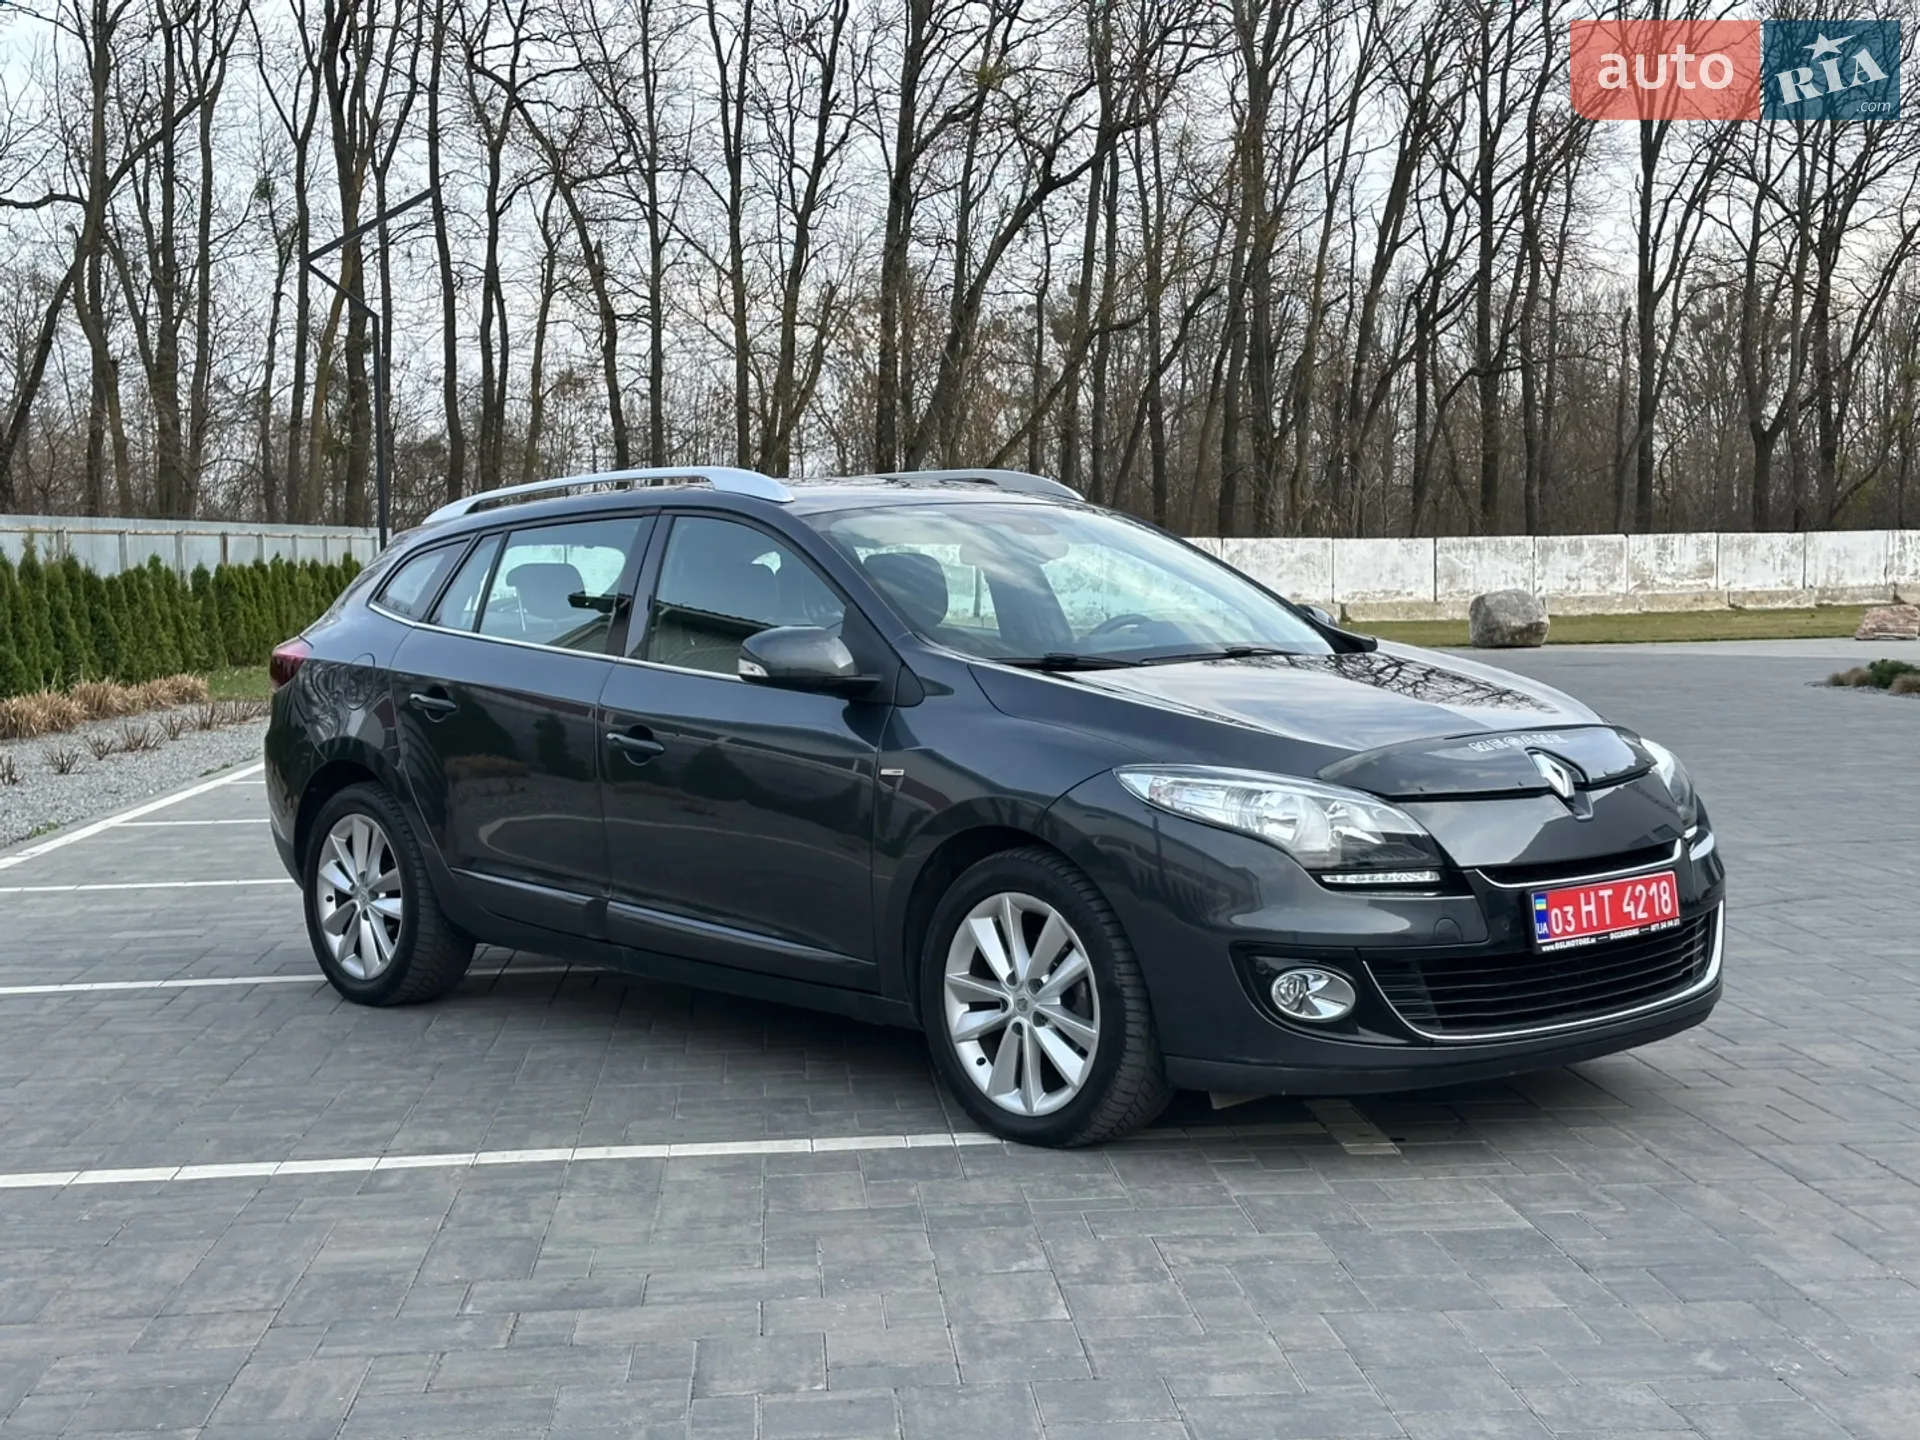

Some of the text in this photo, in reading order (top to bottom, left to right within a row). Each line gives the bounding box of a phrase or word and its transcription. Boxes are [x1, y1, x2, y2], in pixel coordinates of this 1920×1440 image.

[1551, 880, 1672, 935] 03 HT 4218
[1537, 922, 1549, 935] UA
